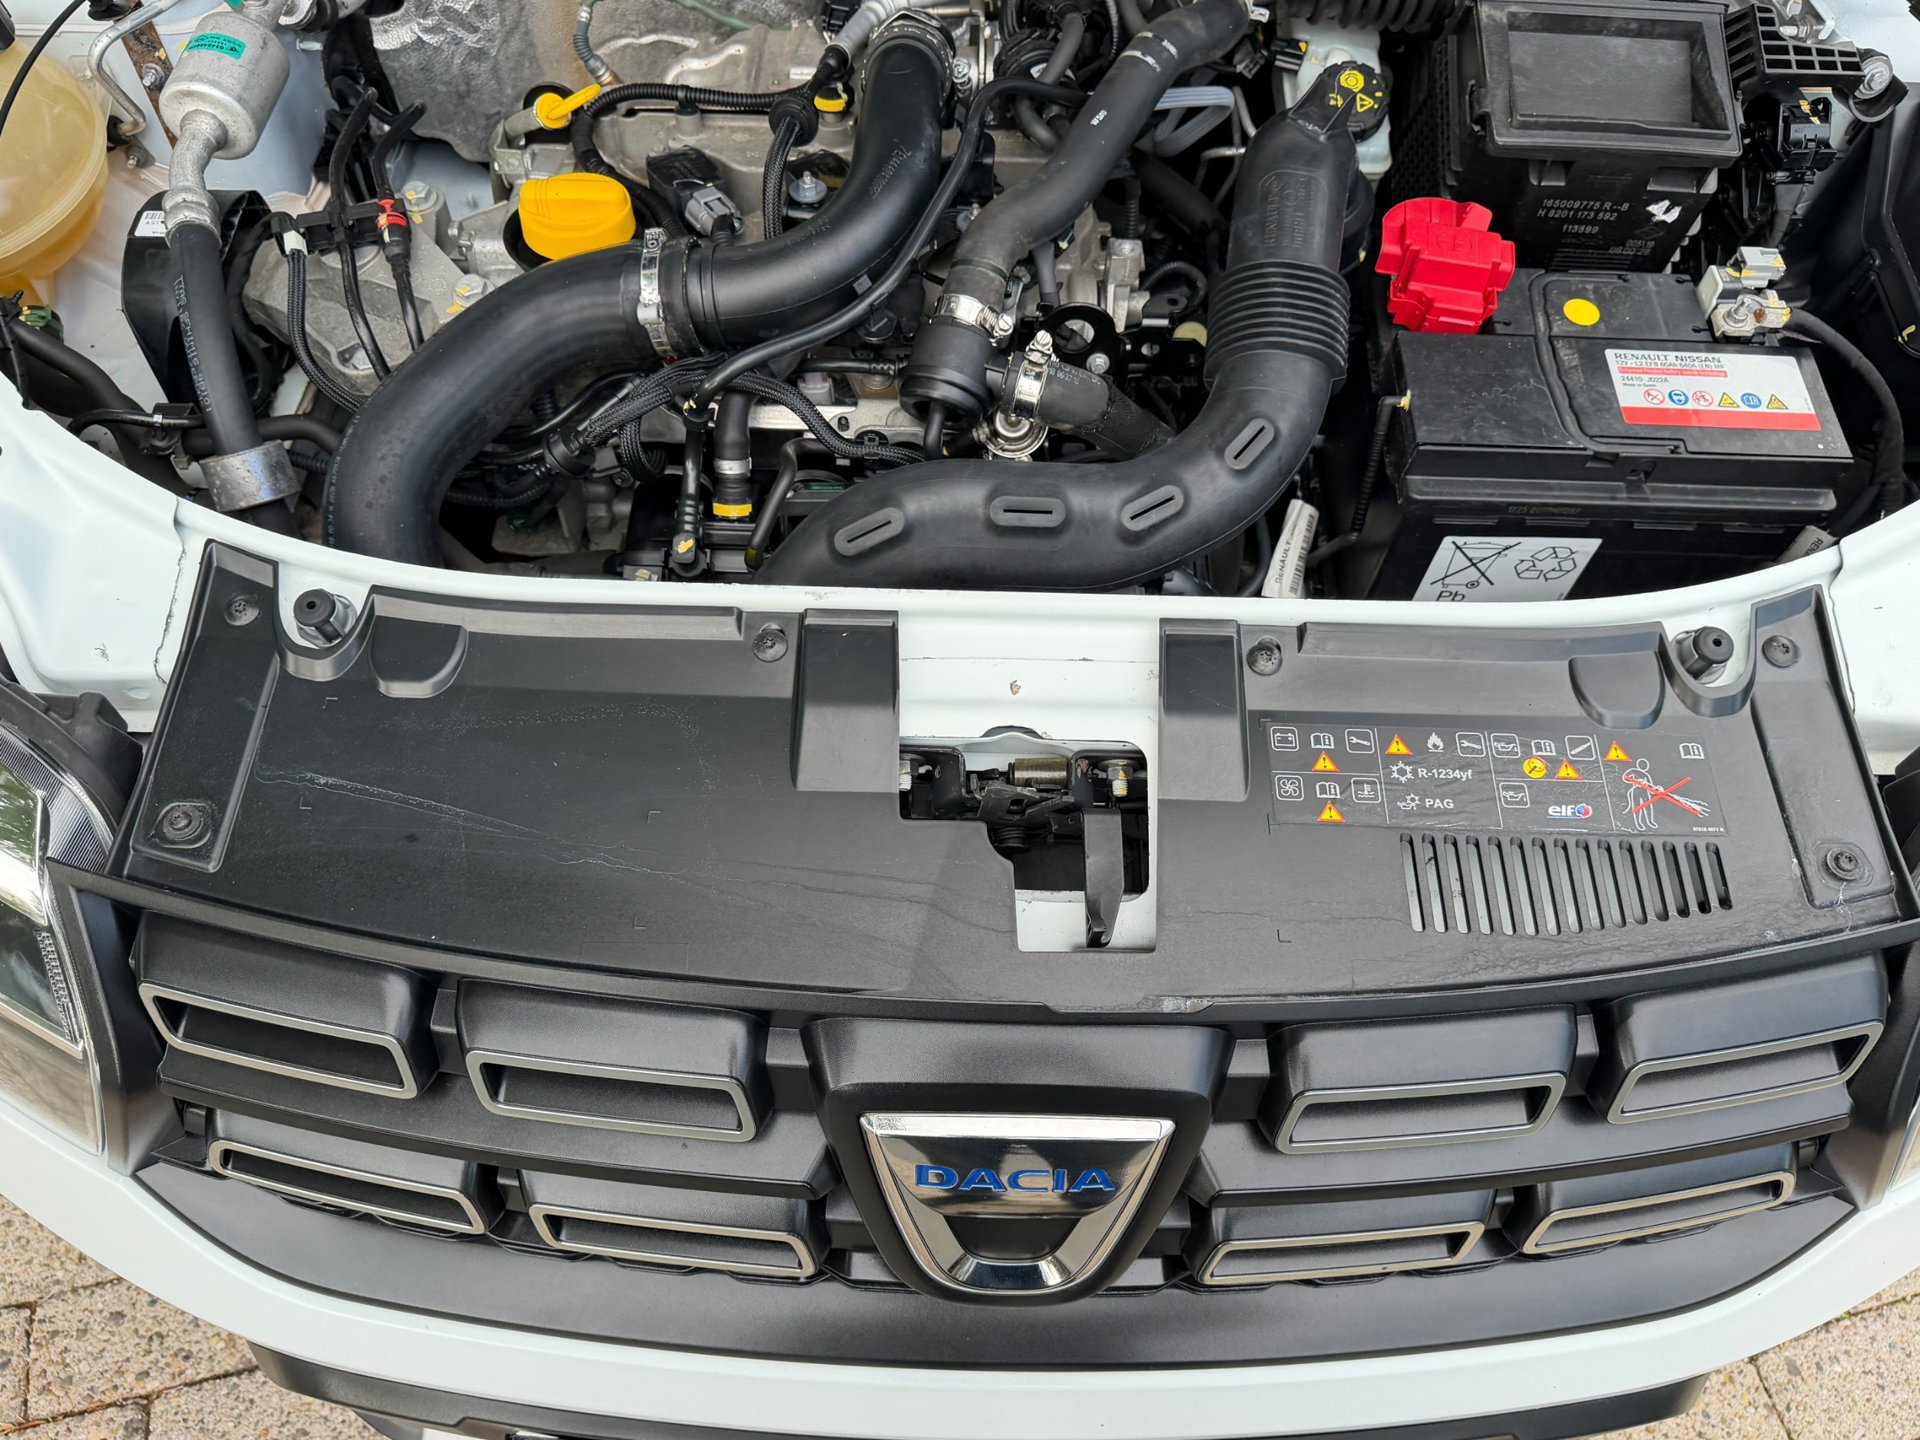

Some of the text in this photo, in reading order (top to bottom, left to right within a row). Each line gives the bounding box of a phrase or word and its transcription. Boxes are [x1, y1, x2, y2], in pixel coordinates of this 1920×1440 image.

[1542, 199, 1601, 210] 165009775
[1577, 211, 1595, 220] 173
[1614, 353, 1722, 364] RENAULT NISSAN
[1436, 590, 1466, 601] Pb
[1417, 767, 1473, 782] R-1234yf
[1424, 798, 1455, 810] PAG
[1547, 804, 1577, 817] elf
[914, 1163, 1119, 1194] DACIA
